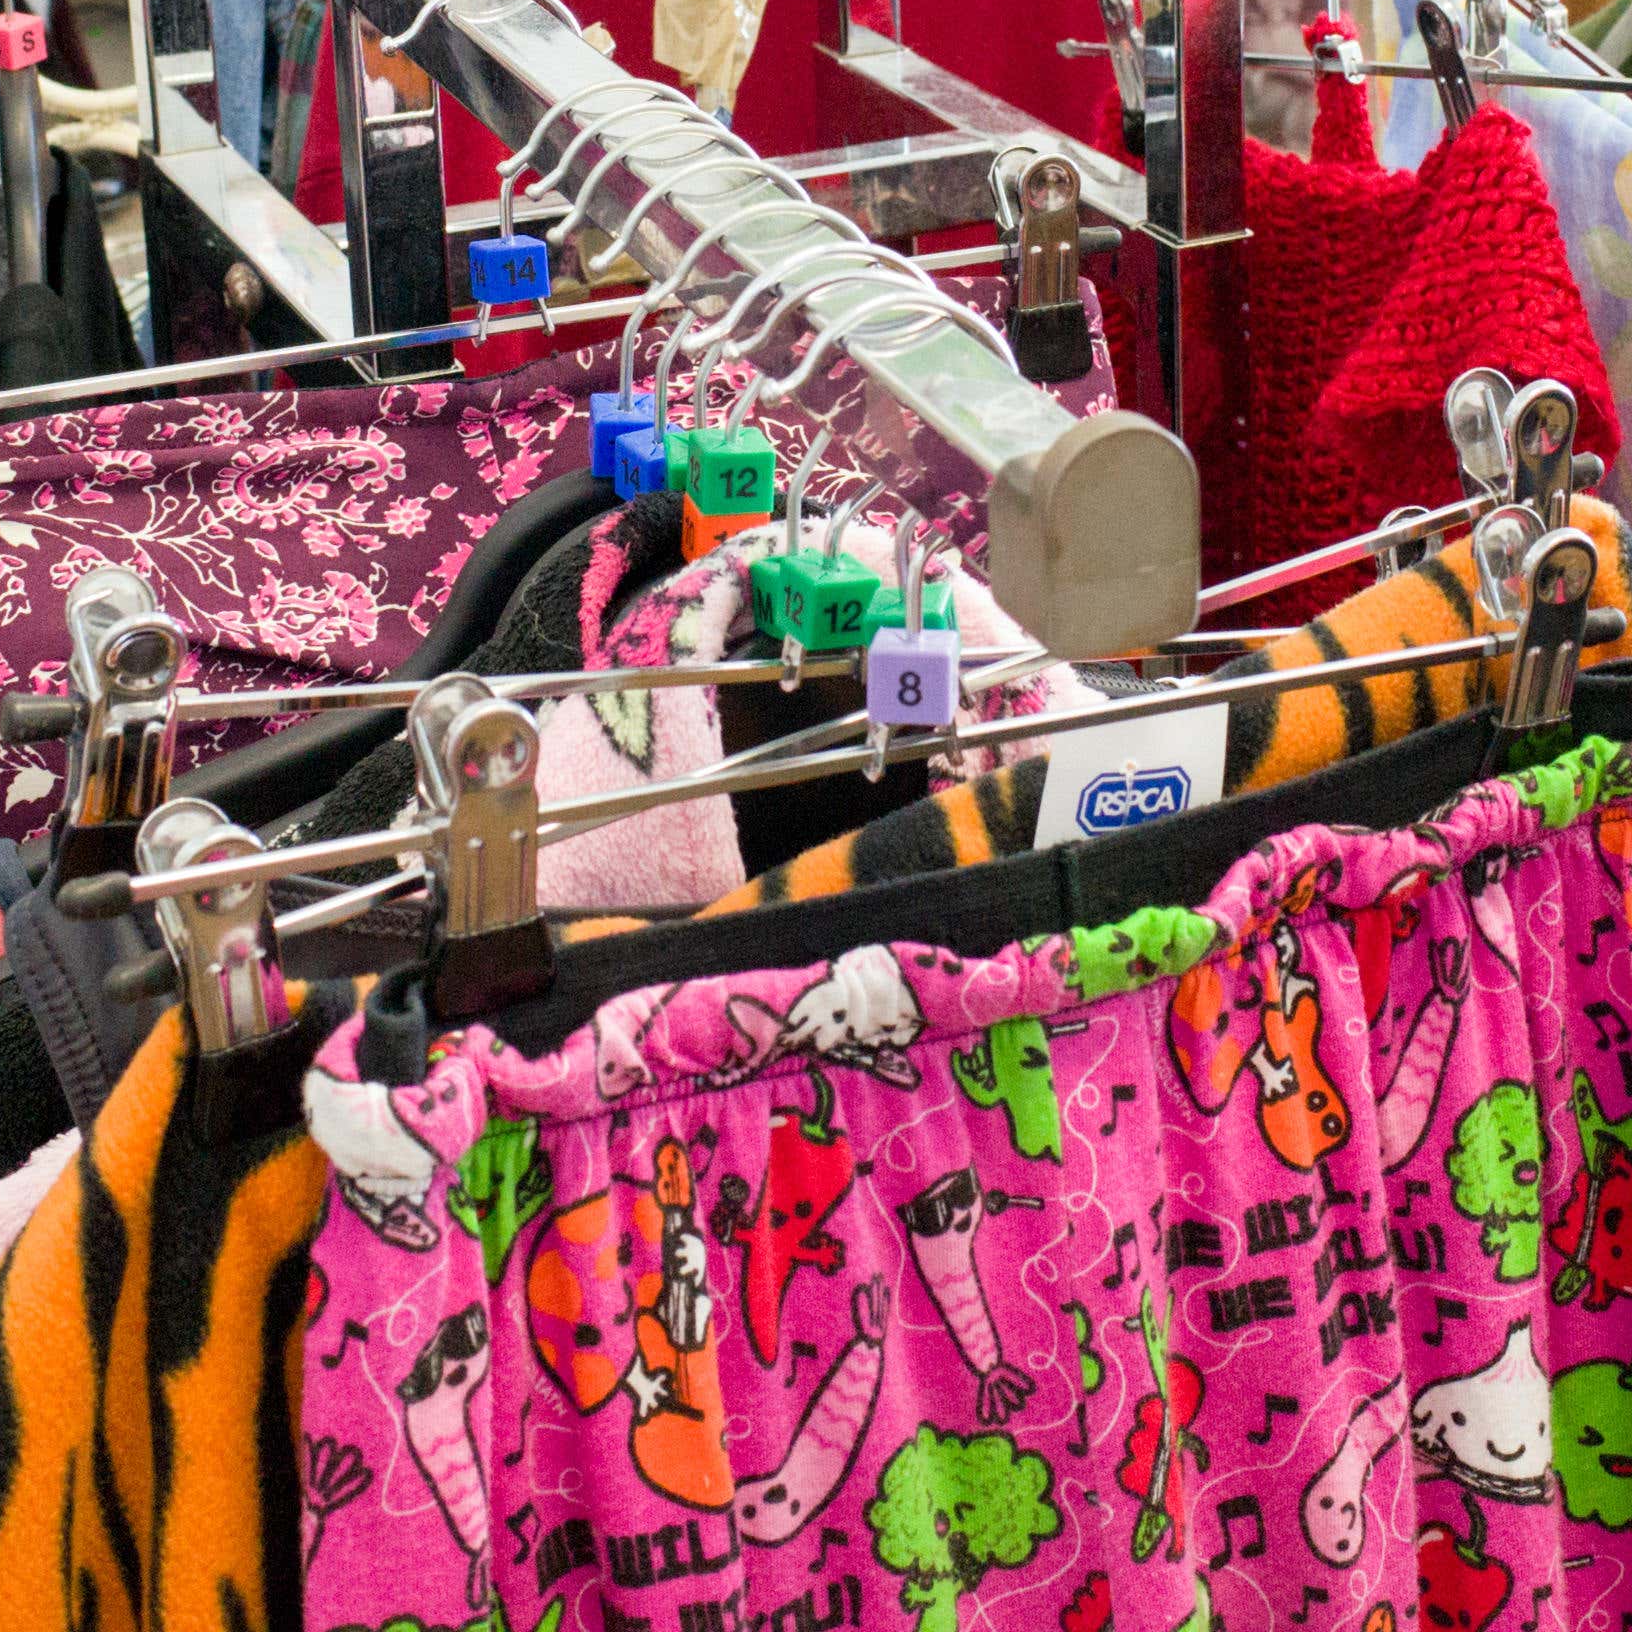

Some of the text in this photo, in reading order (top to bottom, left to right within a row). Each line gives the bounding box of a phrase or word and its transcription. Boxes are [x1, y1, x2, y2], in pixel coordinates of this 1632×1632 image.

[23, 31, 35, 52] S
[504, 256, 536, 285] 14
[621, 458, 641, 492] 14
[718, 467, 760, 499] 12
[758, 585, 774, 625] M
[783, 584, 805, 626] 12
[824, 600, 863, 633] 12
[898, 671, 923, 706] 8
[1093, 785, 1175, 817] RSPCA
